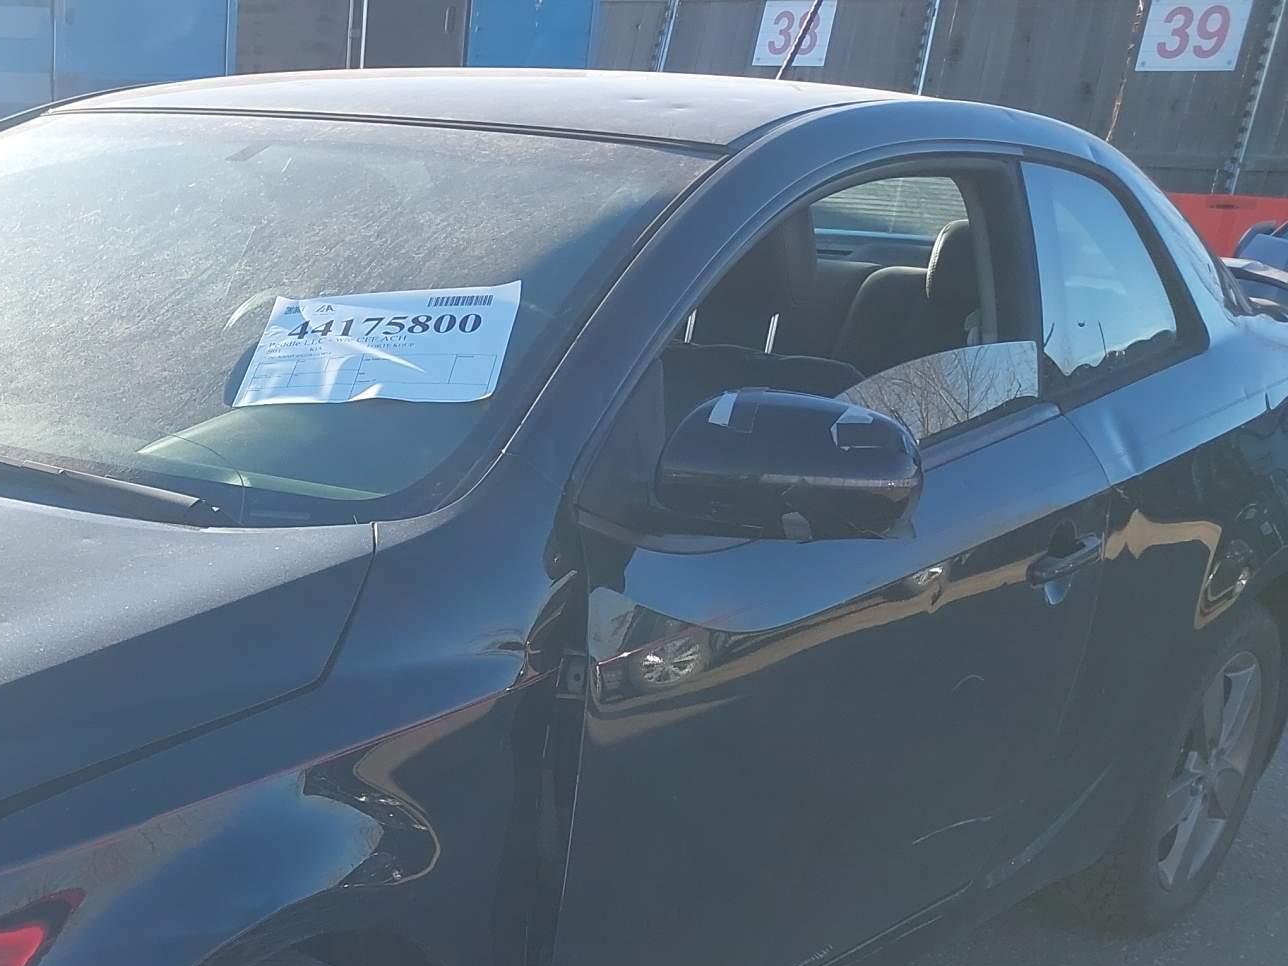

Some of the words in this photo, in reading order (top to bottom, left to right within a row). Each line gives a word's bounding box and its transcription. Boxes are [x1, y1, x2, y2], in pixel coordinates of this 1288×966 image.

[768, 10, 821, 56] 38
[1156, 5, 1231, 59] 39
[287, 313, 482, 339] 44175800
